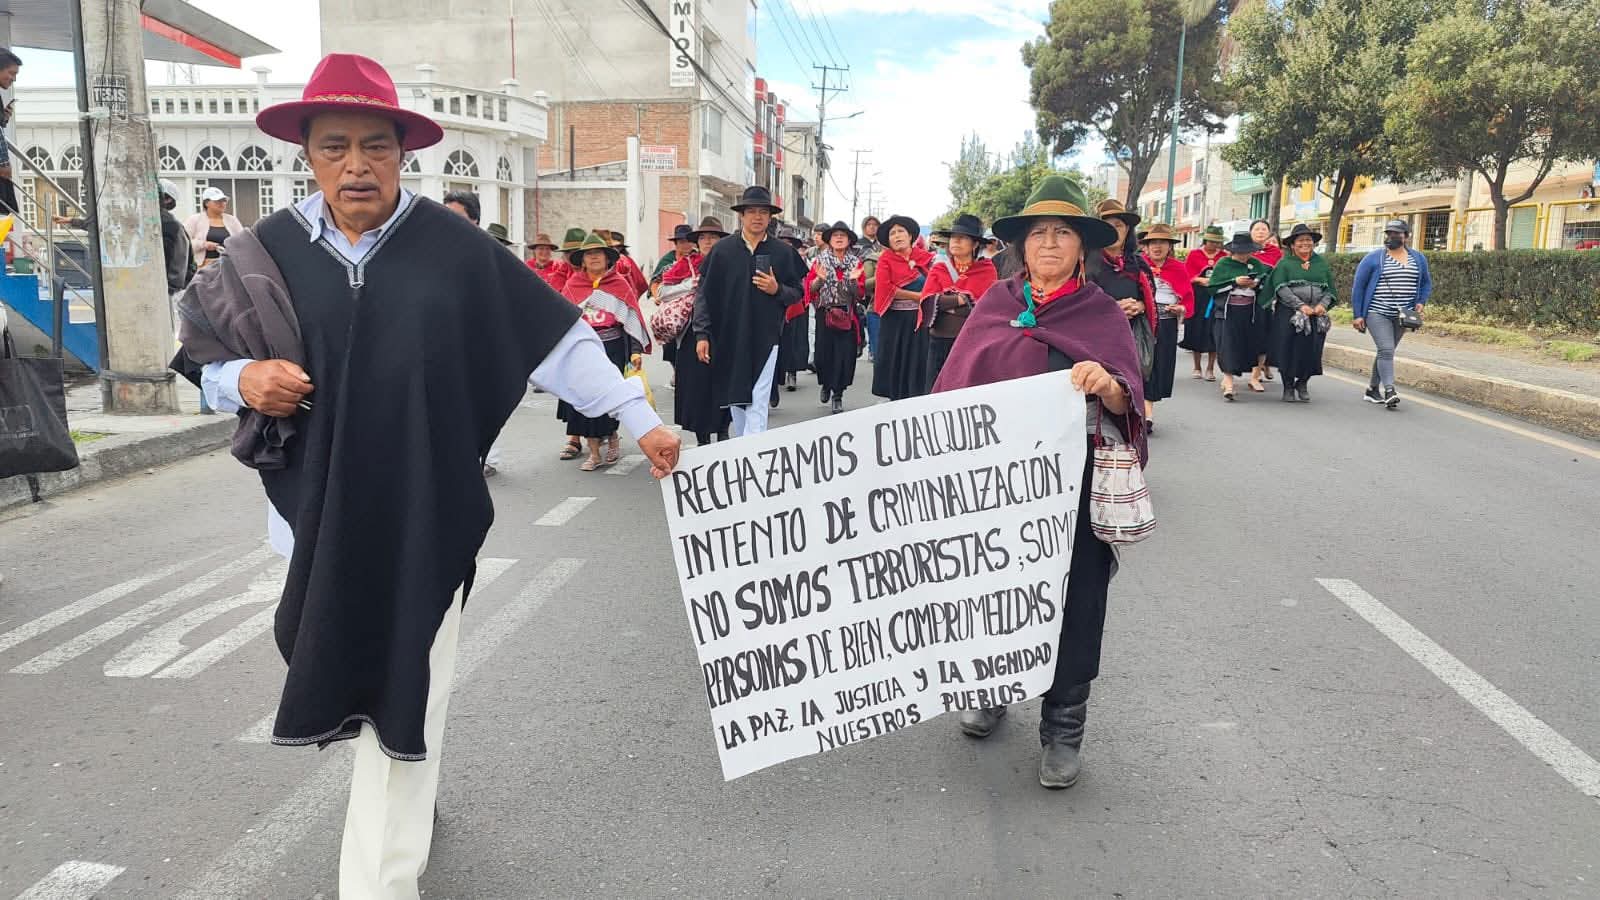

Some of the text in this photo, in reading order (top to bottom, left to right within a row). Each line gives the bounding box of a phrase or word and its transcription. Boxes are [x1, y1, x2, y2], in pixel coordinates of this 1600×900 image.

[94, 87, 126, 102] TESIS
[673, 403, 1000, 516] RECHAZAMOS CUALQUIER
[679, 440, 1075, 579] INTENTO DE CRIMINALIZACIÓN.
[690, 591, 730, 645] NO
[735, 565, 831, 630] SOMOS
[838, 528, 1010, 604] TERRORISTAS
[703, 638, 806, 709] PERSONAS
[806, 629, 838, 678] DE
[840, 618, 892, 670] BIEN,
[888, 581, 1055, 654] COMPROMETIDAS
[718, 721, 746, 750] LA
[750, 708, 794, 740] PAZ,
[801, 699, 824, 727] LA
[835, 677, 905, 715] JUSTICIA
[938, 659, 963, 684] LA
[973, 642, 1052, 681] DIGNIDAD
[816, 681, 1026, 753] NUESTROS PUEBLOS
